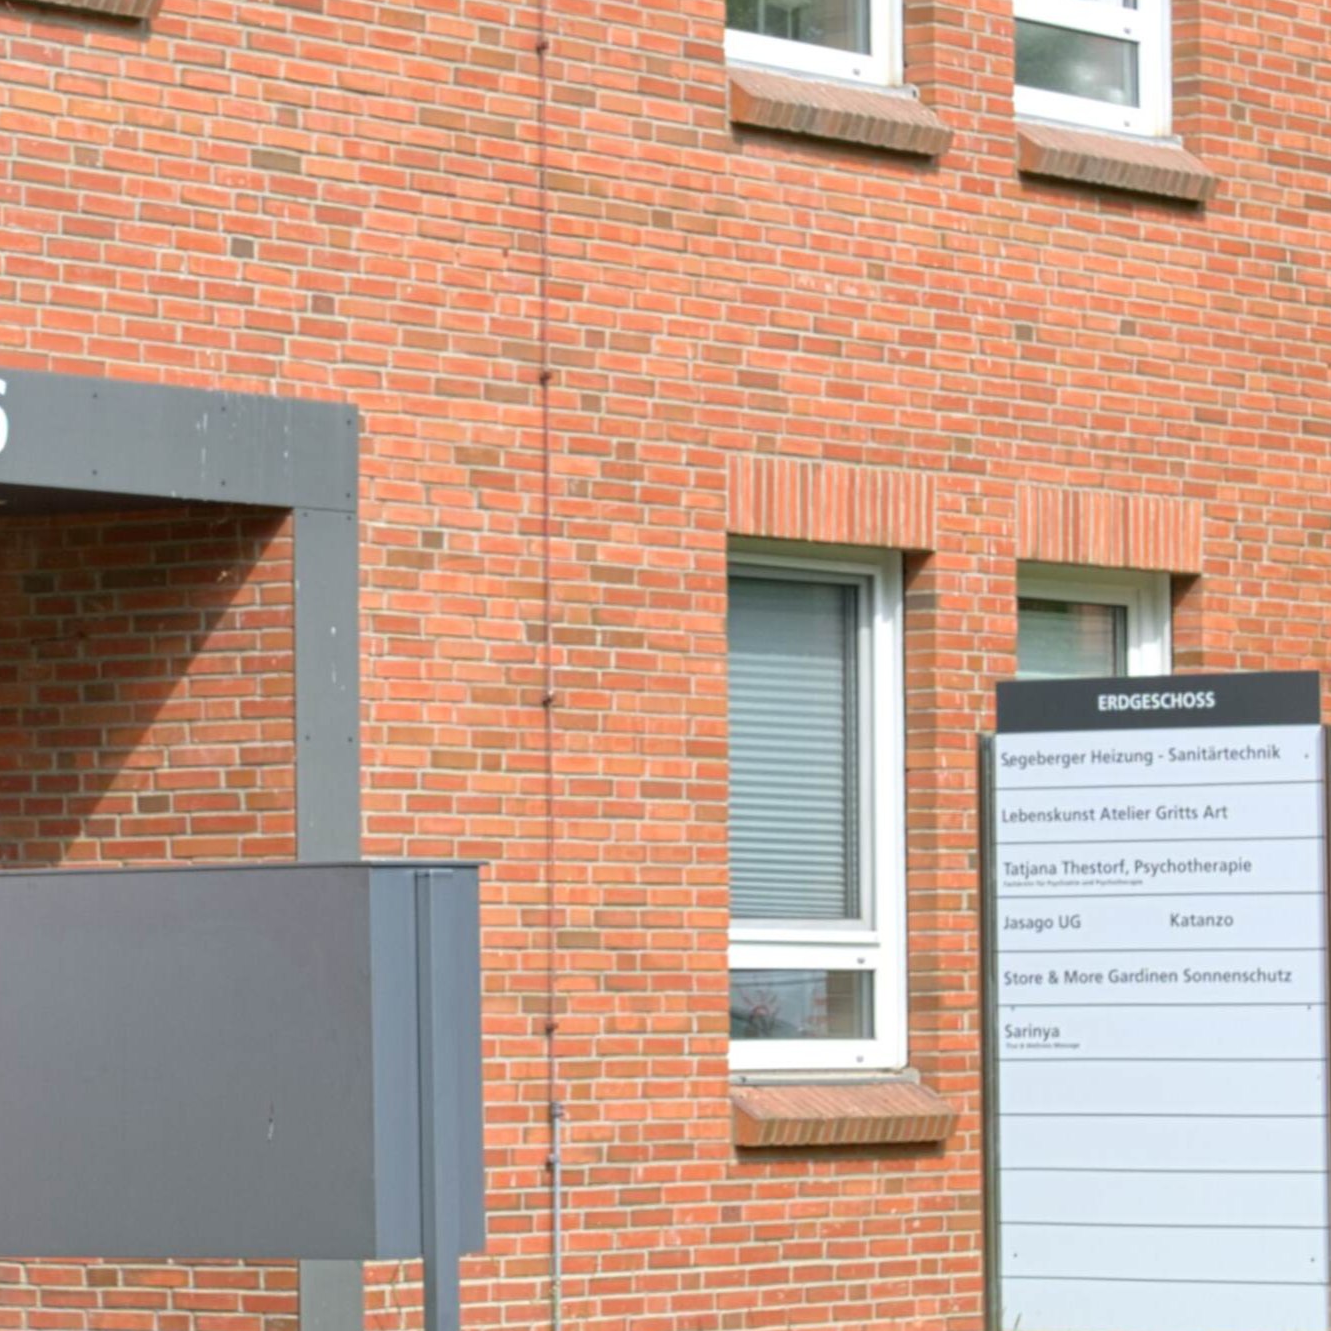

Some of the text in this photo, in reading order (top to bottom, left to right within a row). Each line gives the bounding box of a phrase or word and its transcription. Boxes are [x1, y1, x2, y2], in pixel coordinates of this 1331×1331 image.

[1098, 691, 1216, 712] ERDGESCHOSS
[1001, 750, 1086, 768] Segeberger
[1091, 748, 1153, 767] Heizung
[1169, 744, 1281, 762] Sanitärtechnik
[1002, 803, 1228, 823] Lebenskunst Atelier Gritts Art
[1004, 858, 1251, 879] Tatjana Thestorf, Psychotherapie
[1004, 914, 1081, 932] Jasago UG
[1170, 912, 1234, 928] Katanzo
[1004, 967, 1292, 986] Store & More Gardinen Sonnenschutz
[1005, 1023, 1060, 1041] Sarinya
